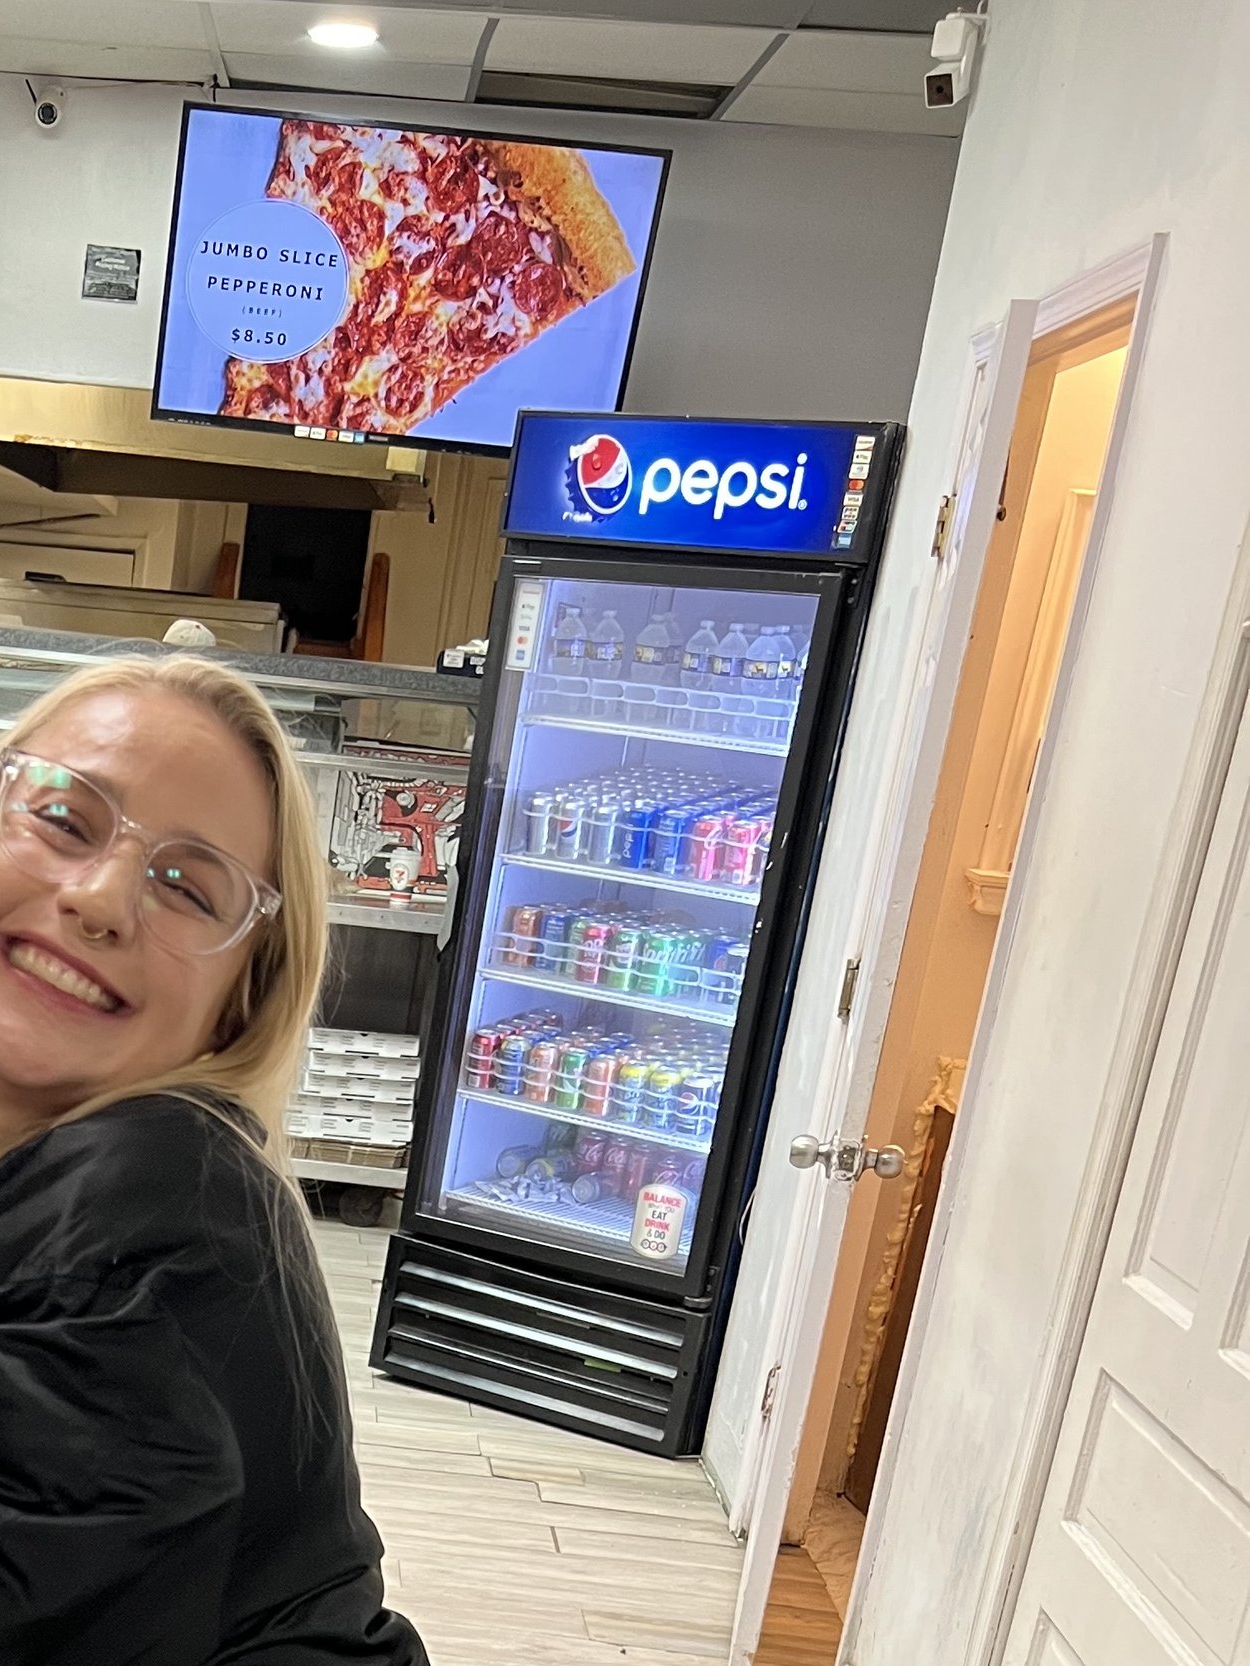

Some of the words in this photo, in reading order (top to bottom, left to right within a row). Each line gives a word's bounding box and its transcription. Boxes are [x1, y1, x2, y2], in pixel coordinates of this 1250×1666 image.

[200, 240, 268, 260] JUMBO
[279, 249, 338, 268] SLICE
[207, 276, 323, 300] PEPPERONI
[231, 328, 287, 345] $8.50
[638, 452, 808, 520] pepsi
[643, 1192, 682, 1208] BALANCE
[652, 1210, 668, 1220] EAT
[644, 1218, 670, 1231] DRINK
[653, 1230, 666, 1240] DO
